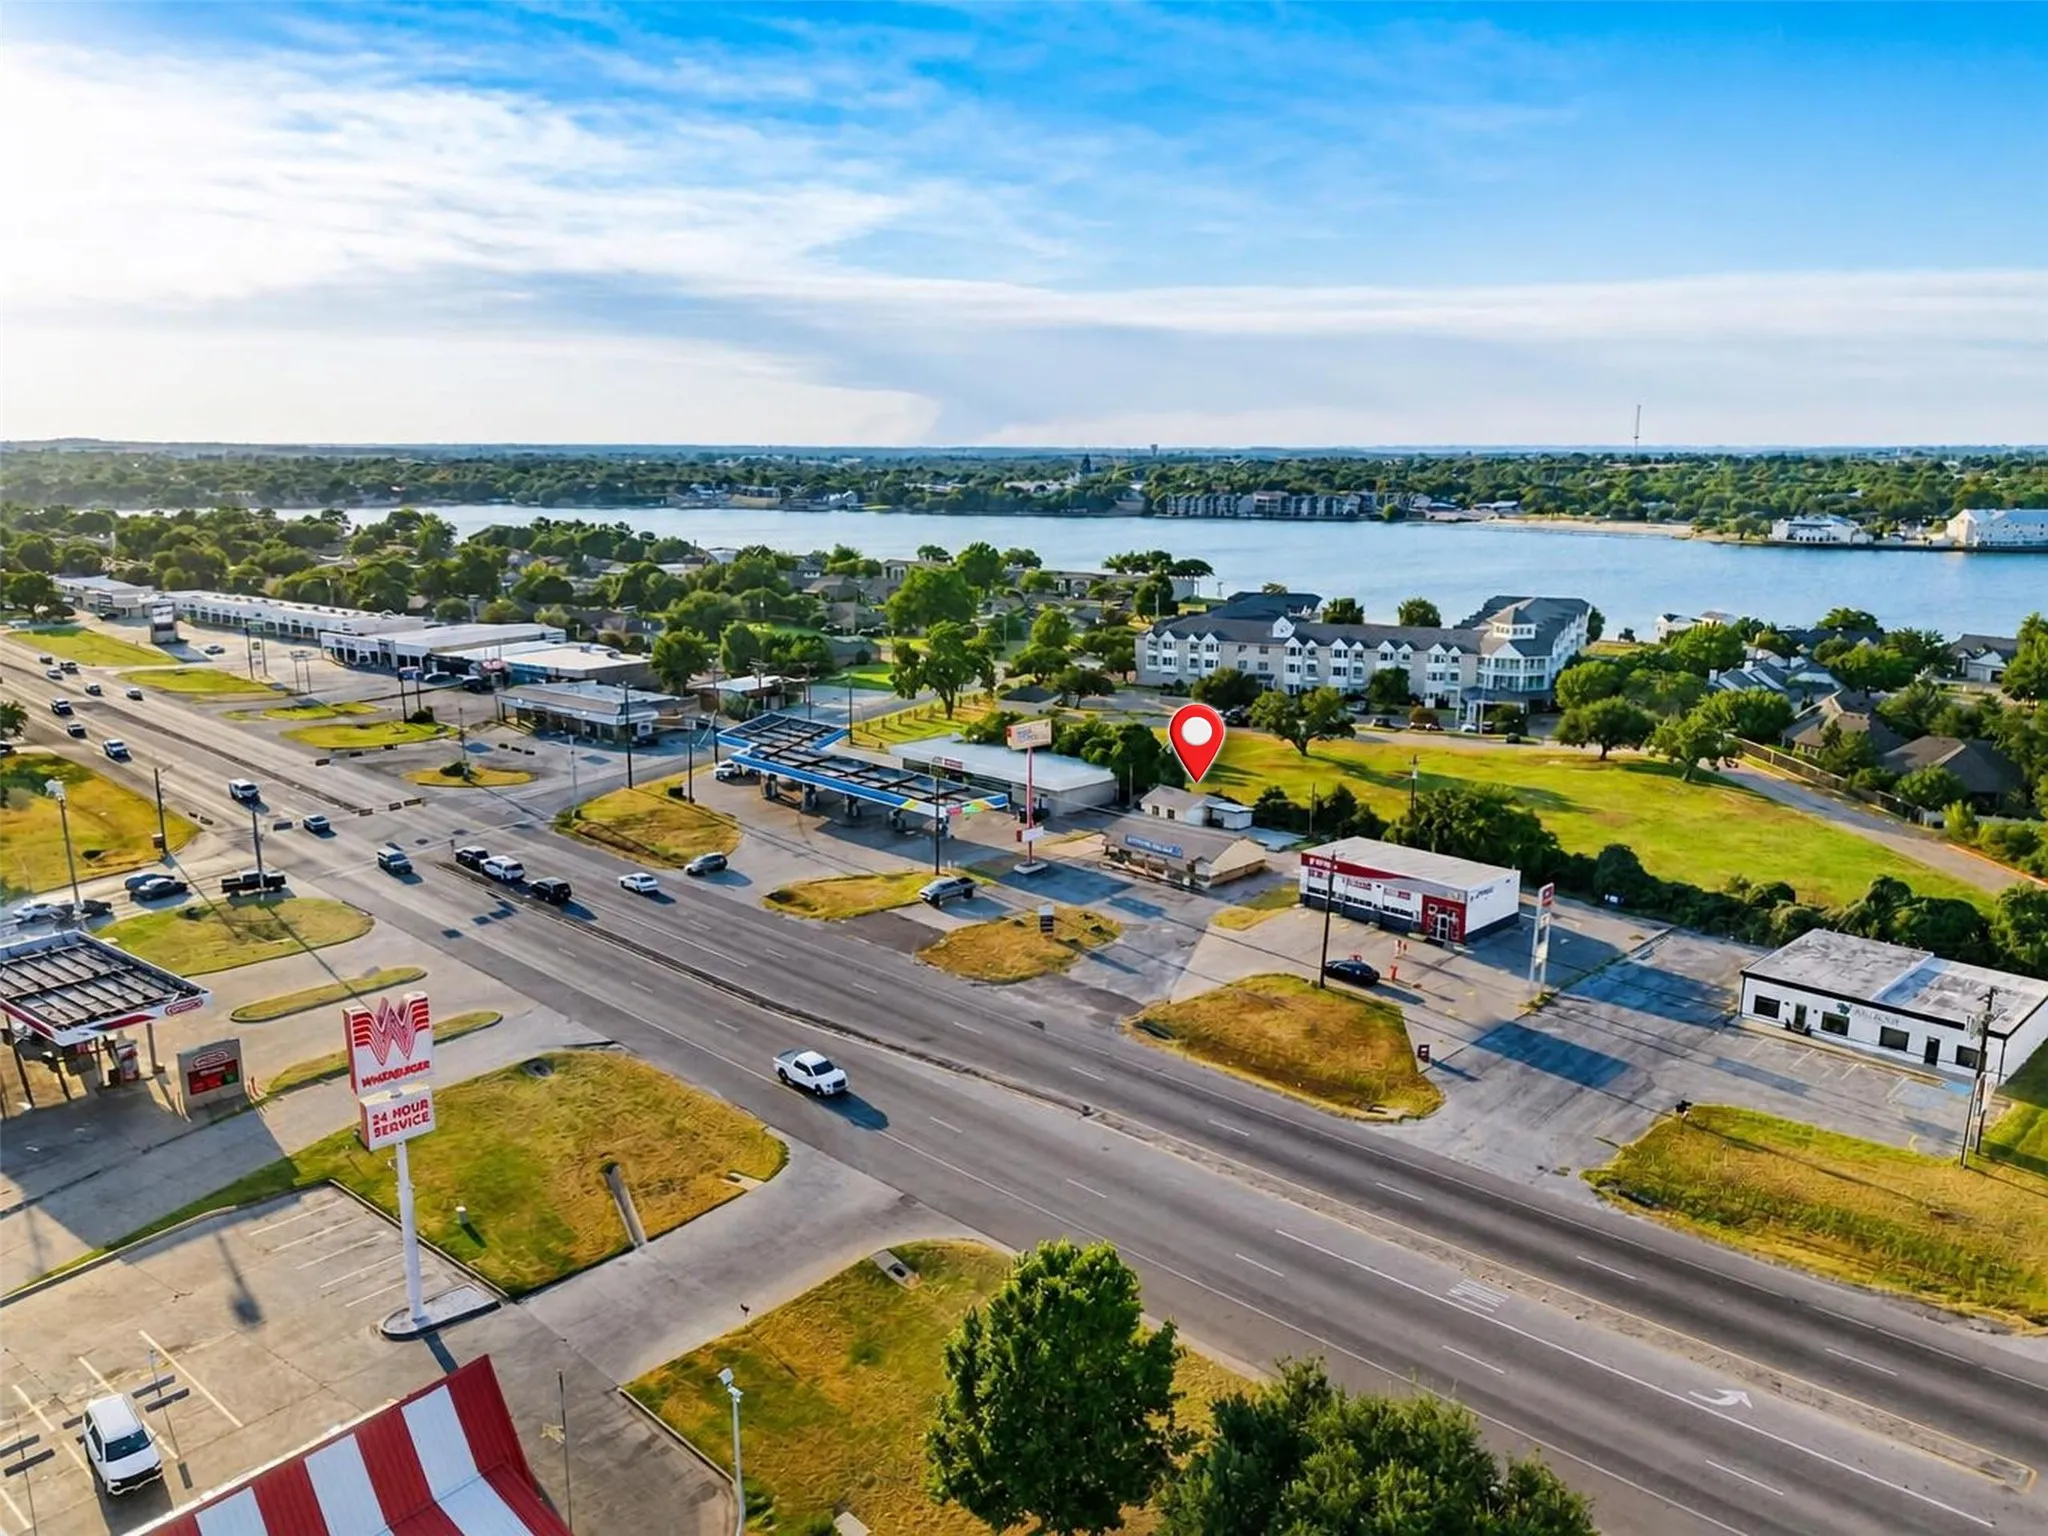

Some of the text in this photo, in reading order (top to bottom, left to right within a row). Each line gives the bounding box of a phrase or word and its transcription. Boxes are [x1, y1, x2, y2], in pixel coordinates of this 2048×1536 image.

[373, 1099, 429, 1126] 24 HOUR
[374, 1111, 431, 1138] SERVICE
